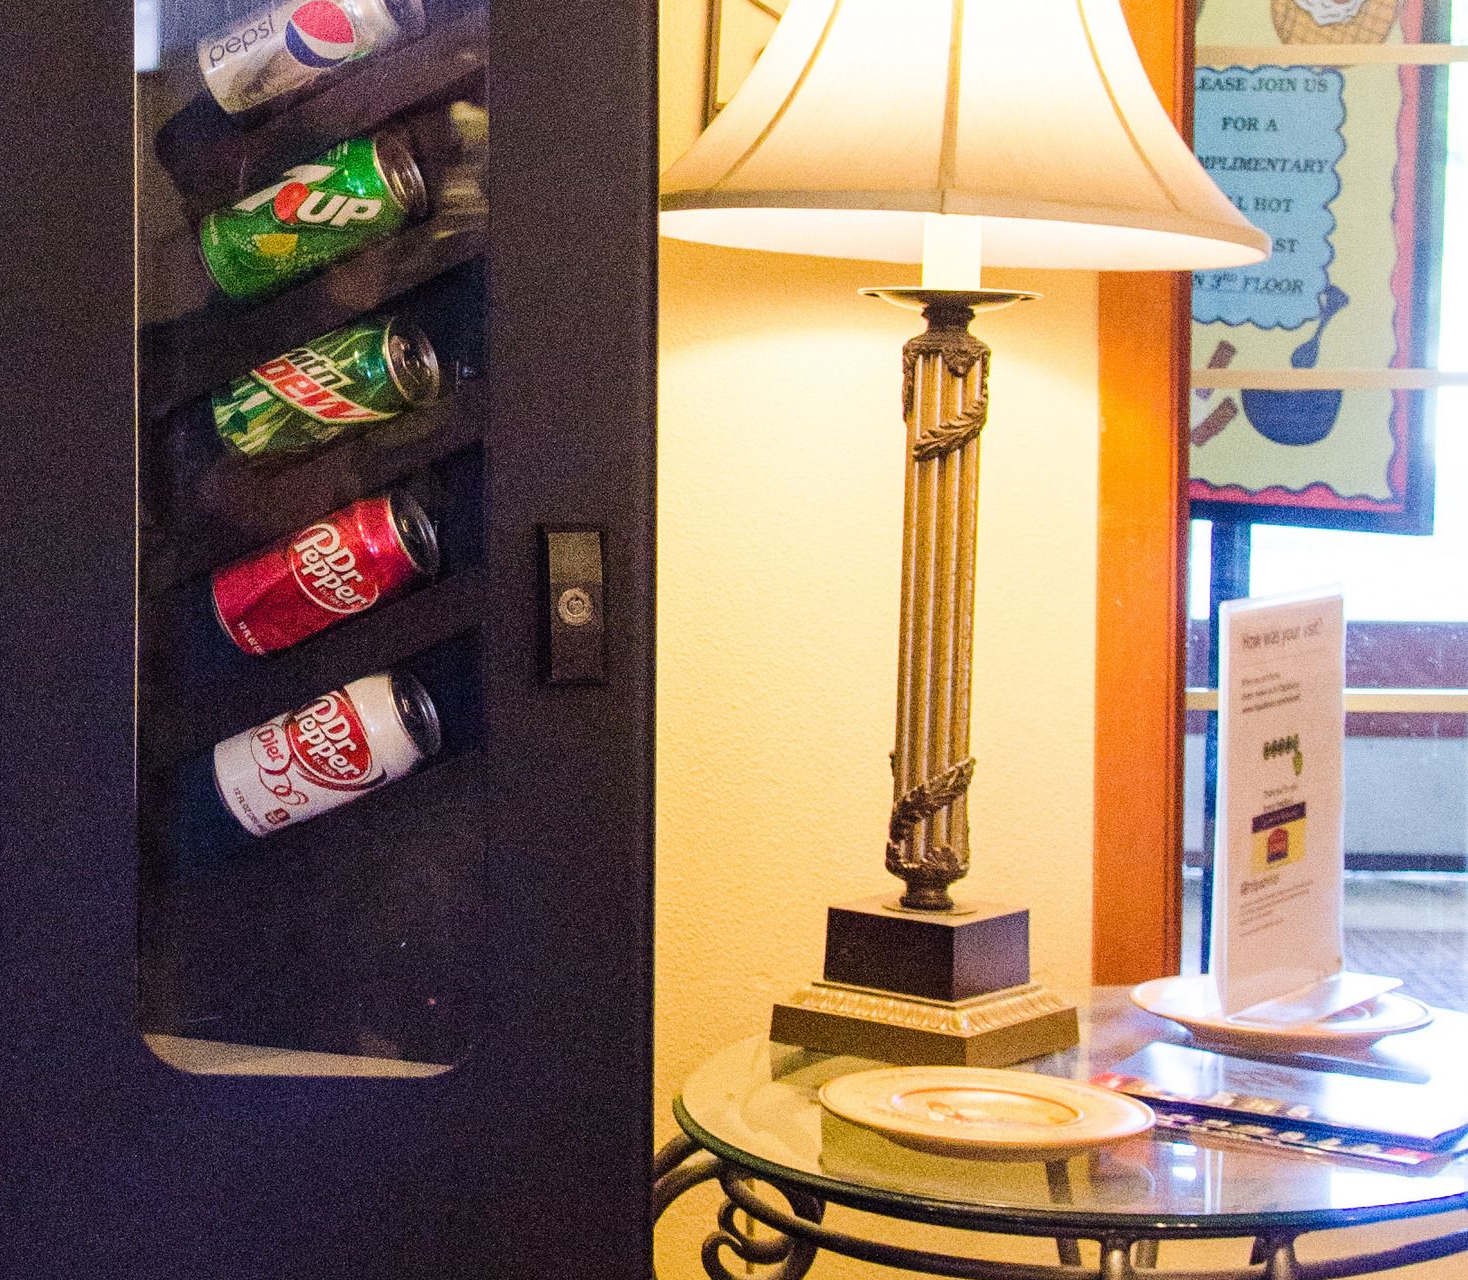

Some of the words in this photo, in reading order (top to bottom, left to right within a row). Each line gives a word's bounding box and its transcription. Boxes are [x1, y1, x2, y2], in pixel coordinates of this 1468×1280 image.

[209, 15, 277, 68] pepsi
[1195, 77, 1247, 92] EASE
[1252, 78, 1297, 92] JOIN
[1304, 79, 1329, 93] US
[1222, 116, 1259, 131] FOR
[1265, 118, 1279, 131] A
[1196, 156, 1329, 174] MPLIMENTARY
[1254, 197, 1295, 212] HOT
[1243, 275, 1304, 294] FLOOR
[294, 524, 368, 608] Pepper
[329, 549, 364, 584] Dr
[255, 728, 285, 763] Diet
[293, 696, 360, 780] Pepper
[322, 721, 357, 756] Dr
